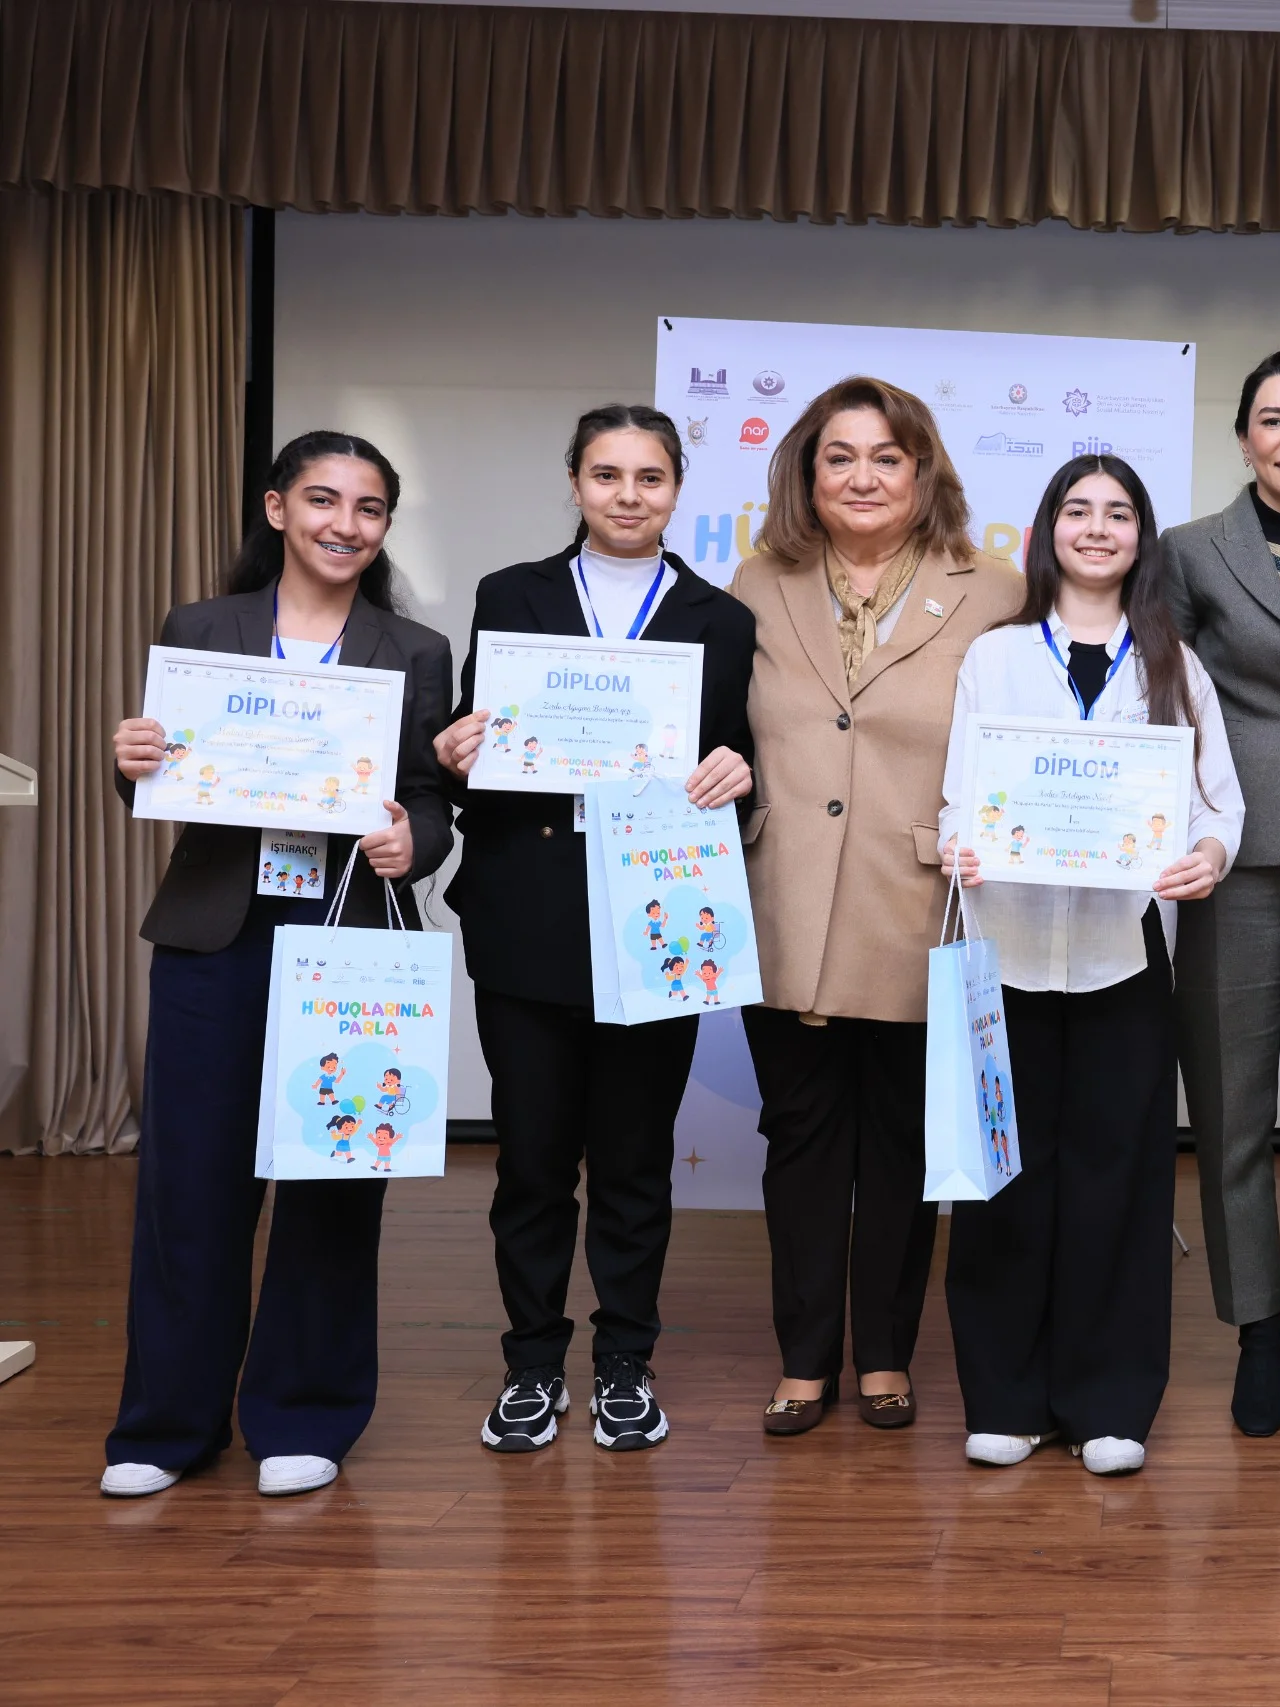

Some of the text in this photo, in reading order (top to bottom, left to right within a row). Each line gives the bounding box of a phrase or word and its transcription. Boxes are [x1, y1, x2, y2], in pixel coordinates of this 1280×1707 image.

[743, 426, 768, 436] nar
[546, 668, 630, 693] DİPLOM
[227, 692, 322, 721] DİPLOM
[569, 768, 601, 777] PARLA
[1034, 753, 1119, 779] DİPLOM
[270, 840, 317, 857] İŞTİRAKÇI
[622, 842, 729, 867] HÜQUQLARINLA
[1055, 858, 1087, 869] PARLA
[654, 864, 703, 881] PARLA
[302, 997, 434, 1018] HÜQUQLARINLA
[339, 1020, 398, 1036] PARLA
